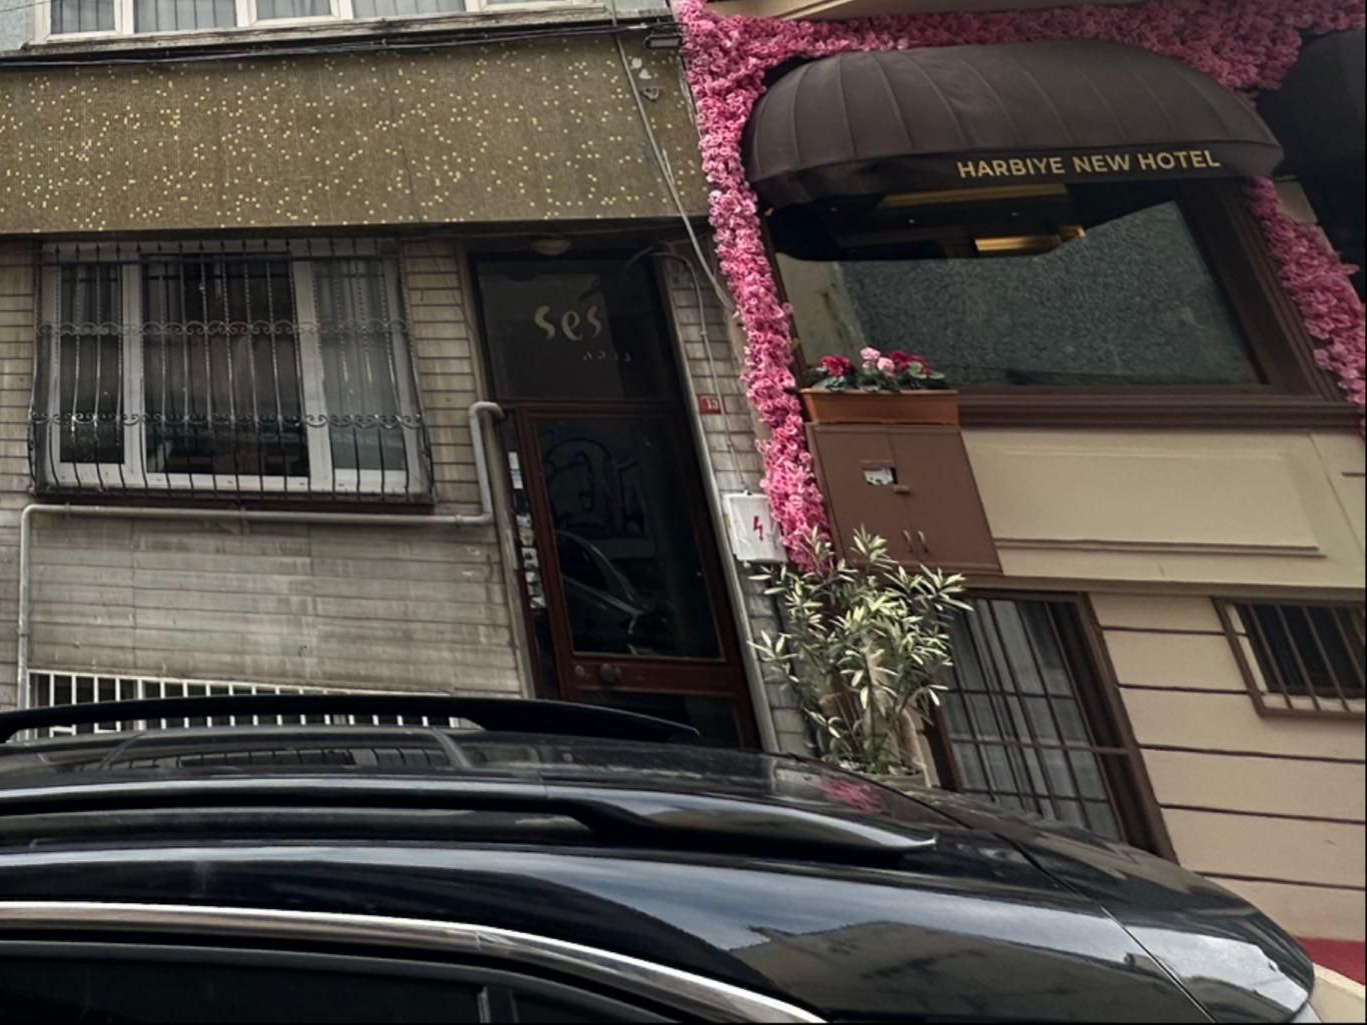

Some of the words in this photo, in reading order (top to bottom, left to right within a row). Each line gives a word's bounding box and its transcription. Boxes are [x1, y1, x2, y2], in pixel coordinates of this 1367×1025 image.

[957, 157, 1065, 178] HARBIYE
[1073, 153, 1130, 173] NEW
[1137, 149, 1221, 171] HOTEL
